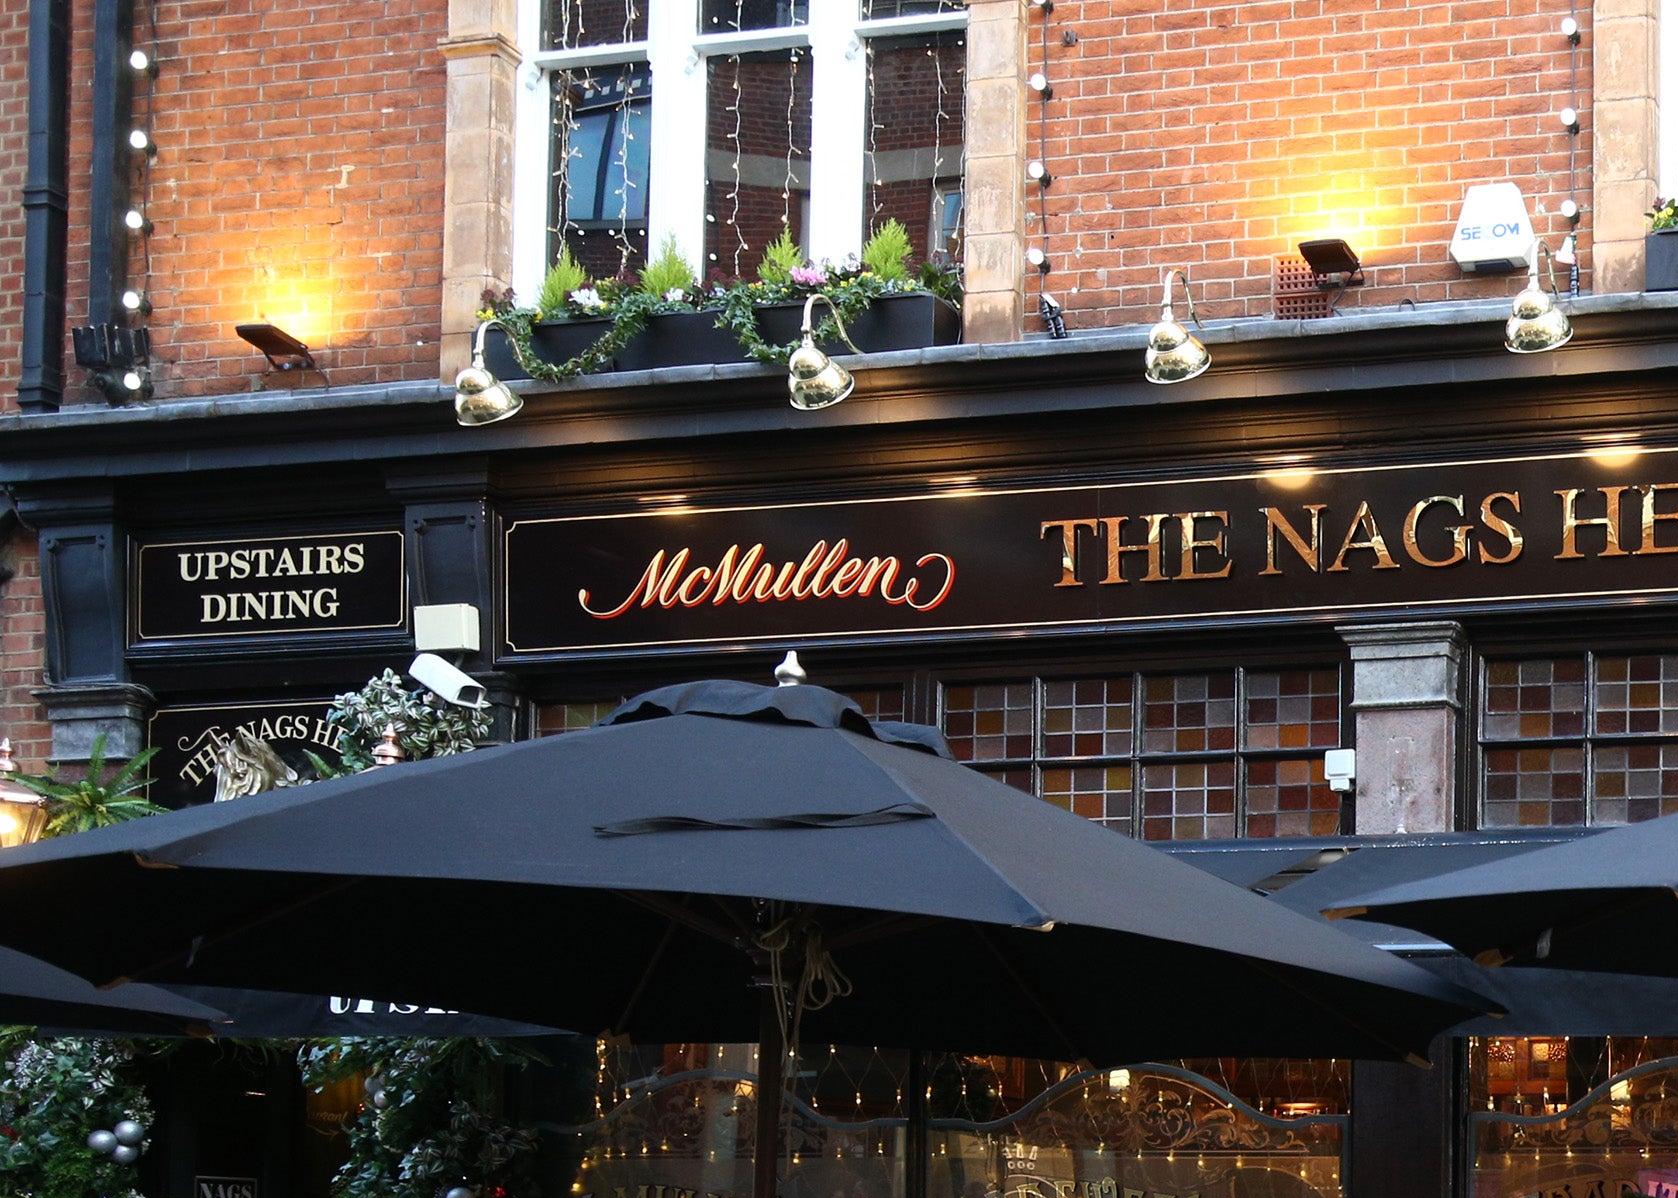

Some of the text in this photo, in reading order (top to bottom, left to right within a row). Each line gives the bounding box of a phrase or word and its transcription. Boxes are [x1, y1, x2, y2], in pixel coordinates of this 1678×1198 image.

[1461, 223, 1519, 240] SEOM
[1039, 509, 1234, 588] THE
[1257, 490, 1524, 577] NAGS
[178, 543, 365, 582] UPSTAIRS
[578, 537, 956, 618] McMullen
[200, 588, 340, 623] DINING
[235, 714, 311, 741] NAGS
